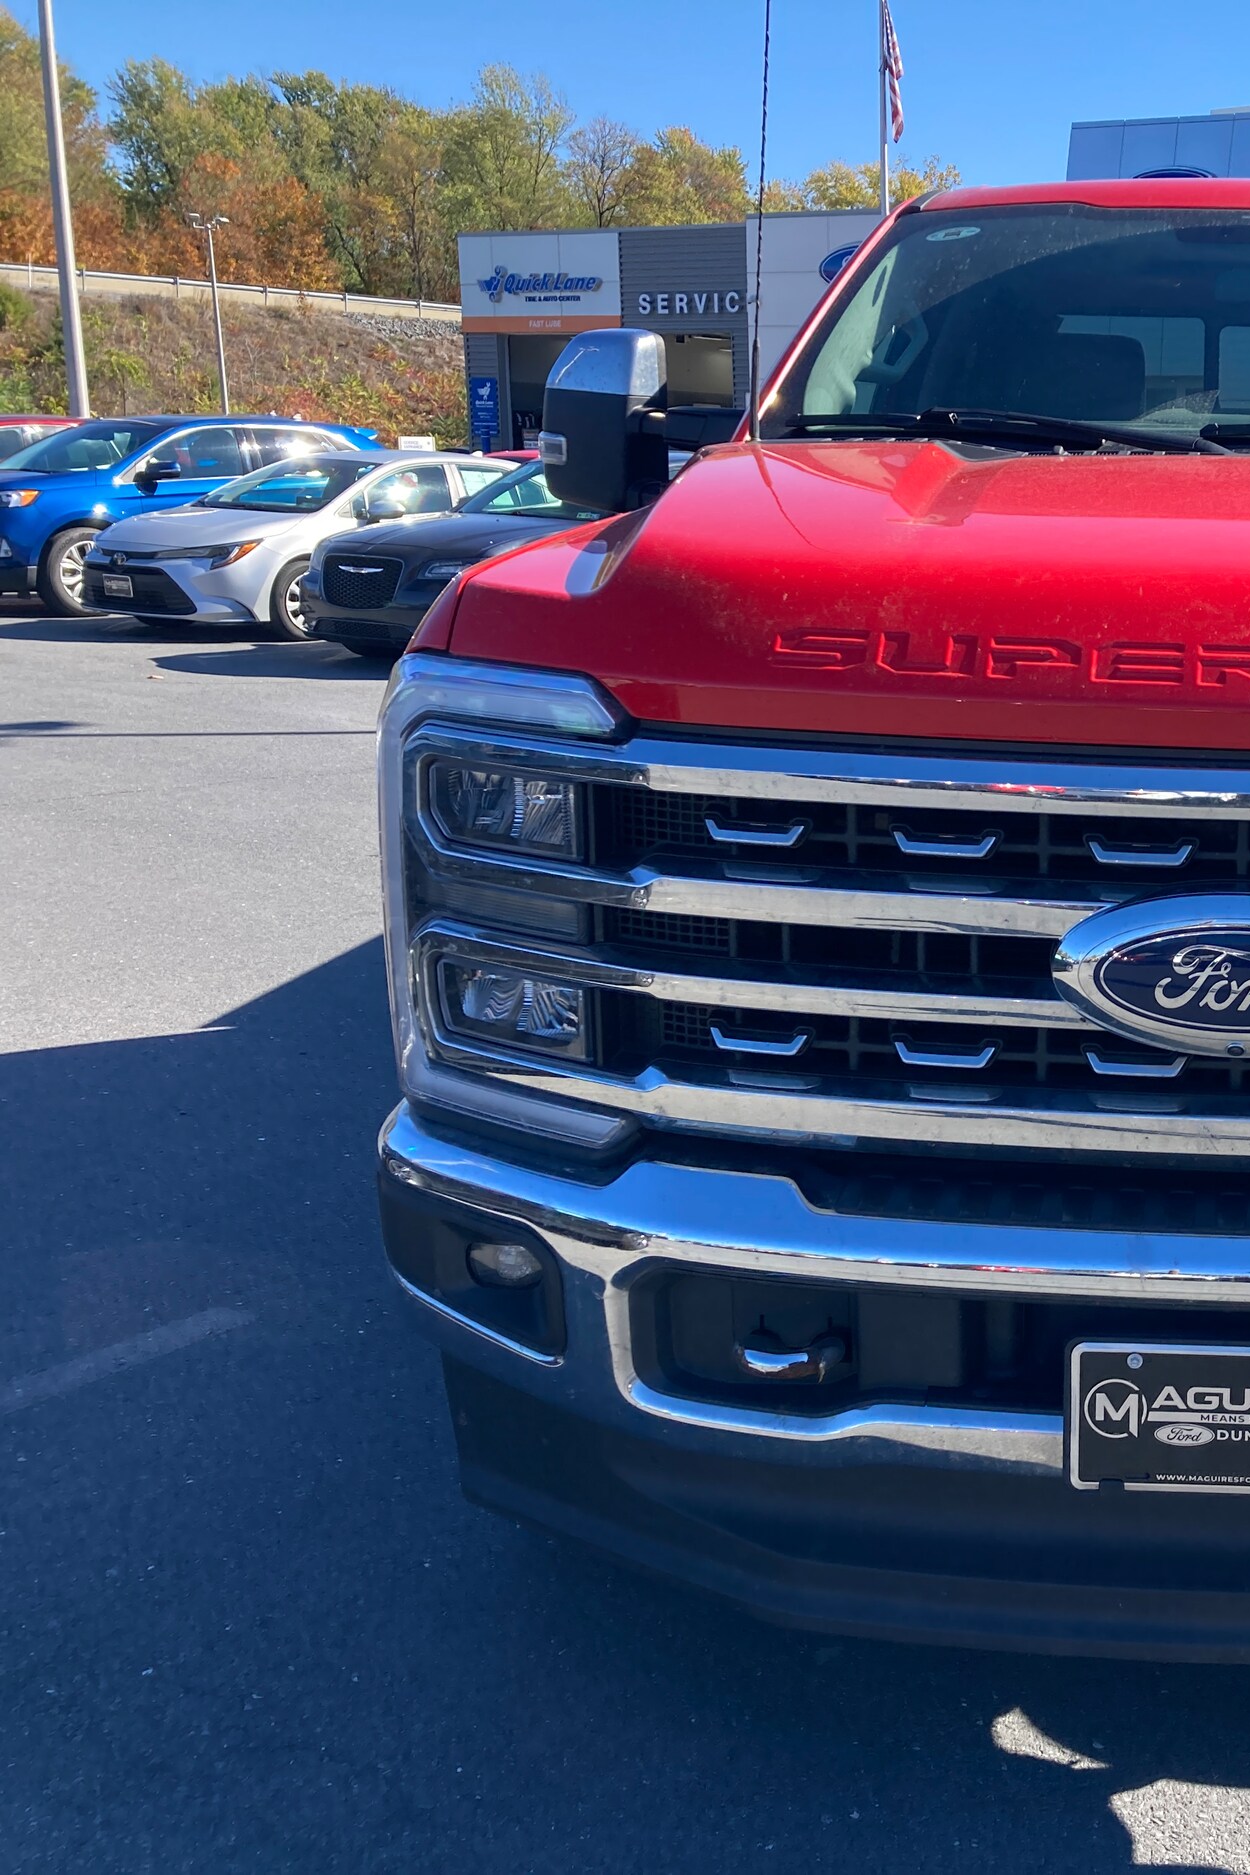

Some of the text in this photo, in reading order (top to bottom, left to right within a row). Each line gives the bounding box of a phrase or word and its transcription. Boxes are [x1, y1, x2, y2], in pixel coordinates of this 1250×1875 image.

[503, 273, 599, 294] Quick Lane
[638, 291, 740, 315] SERVIC
[1200, 1413, 1245, 1424] MEANS
[1166, 1426, 1202, 1442] Ford
